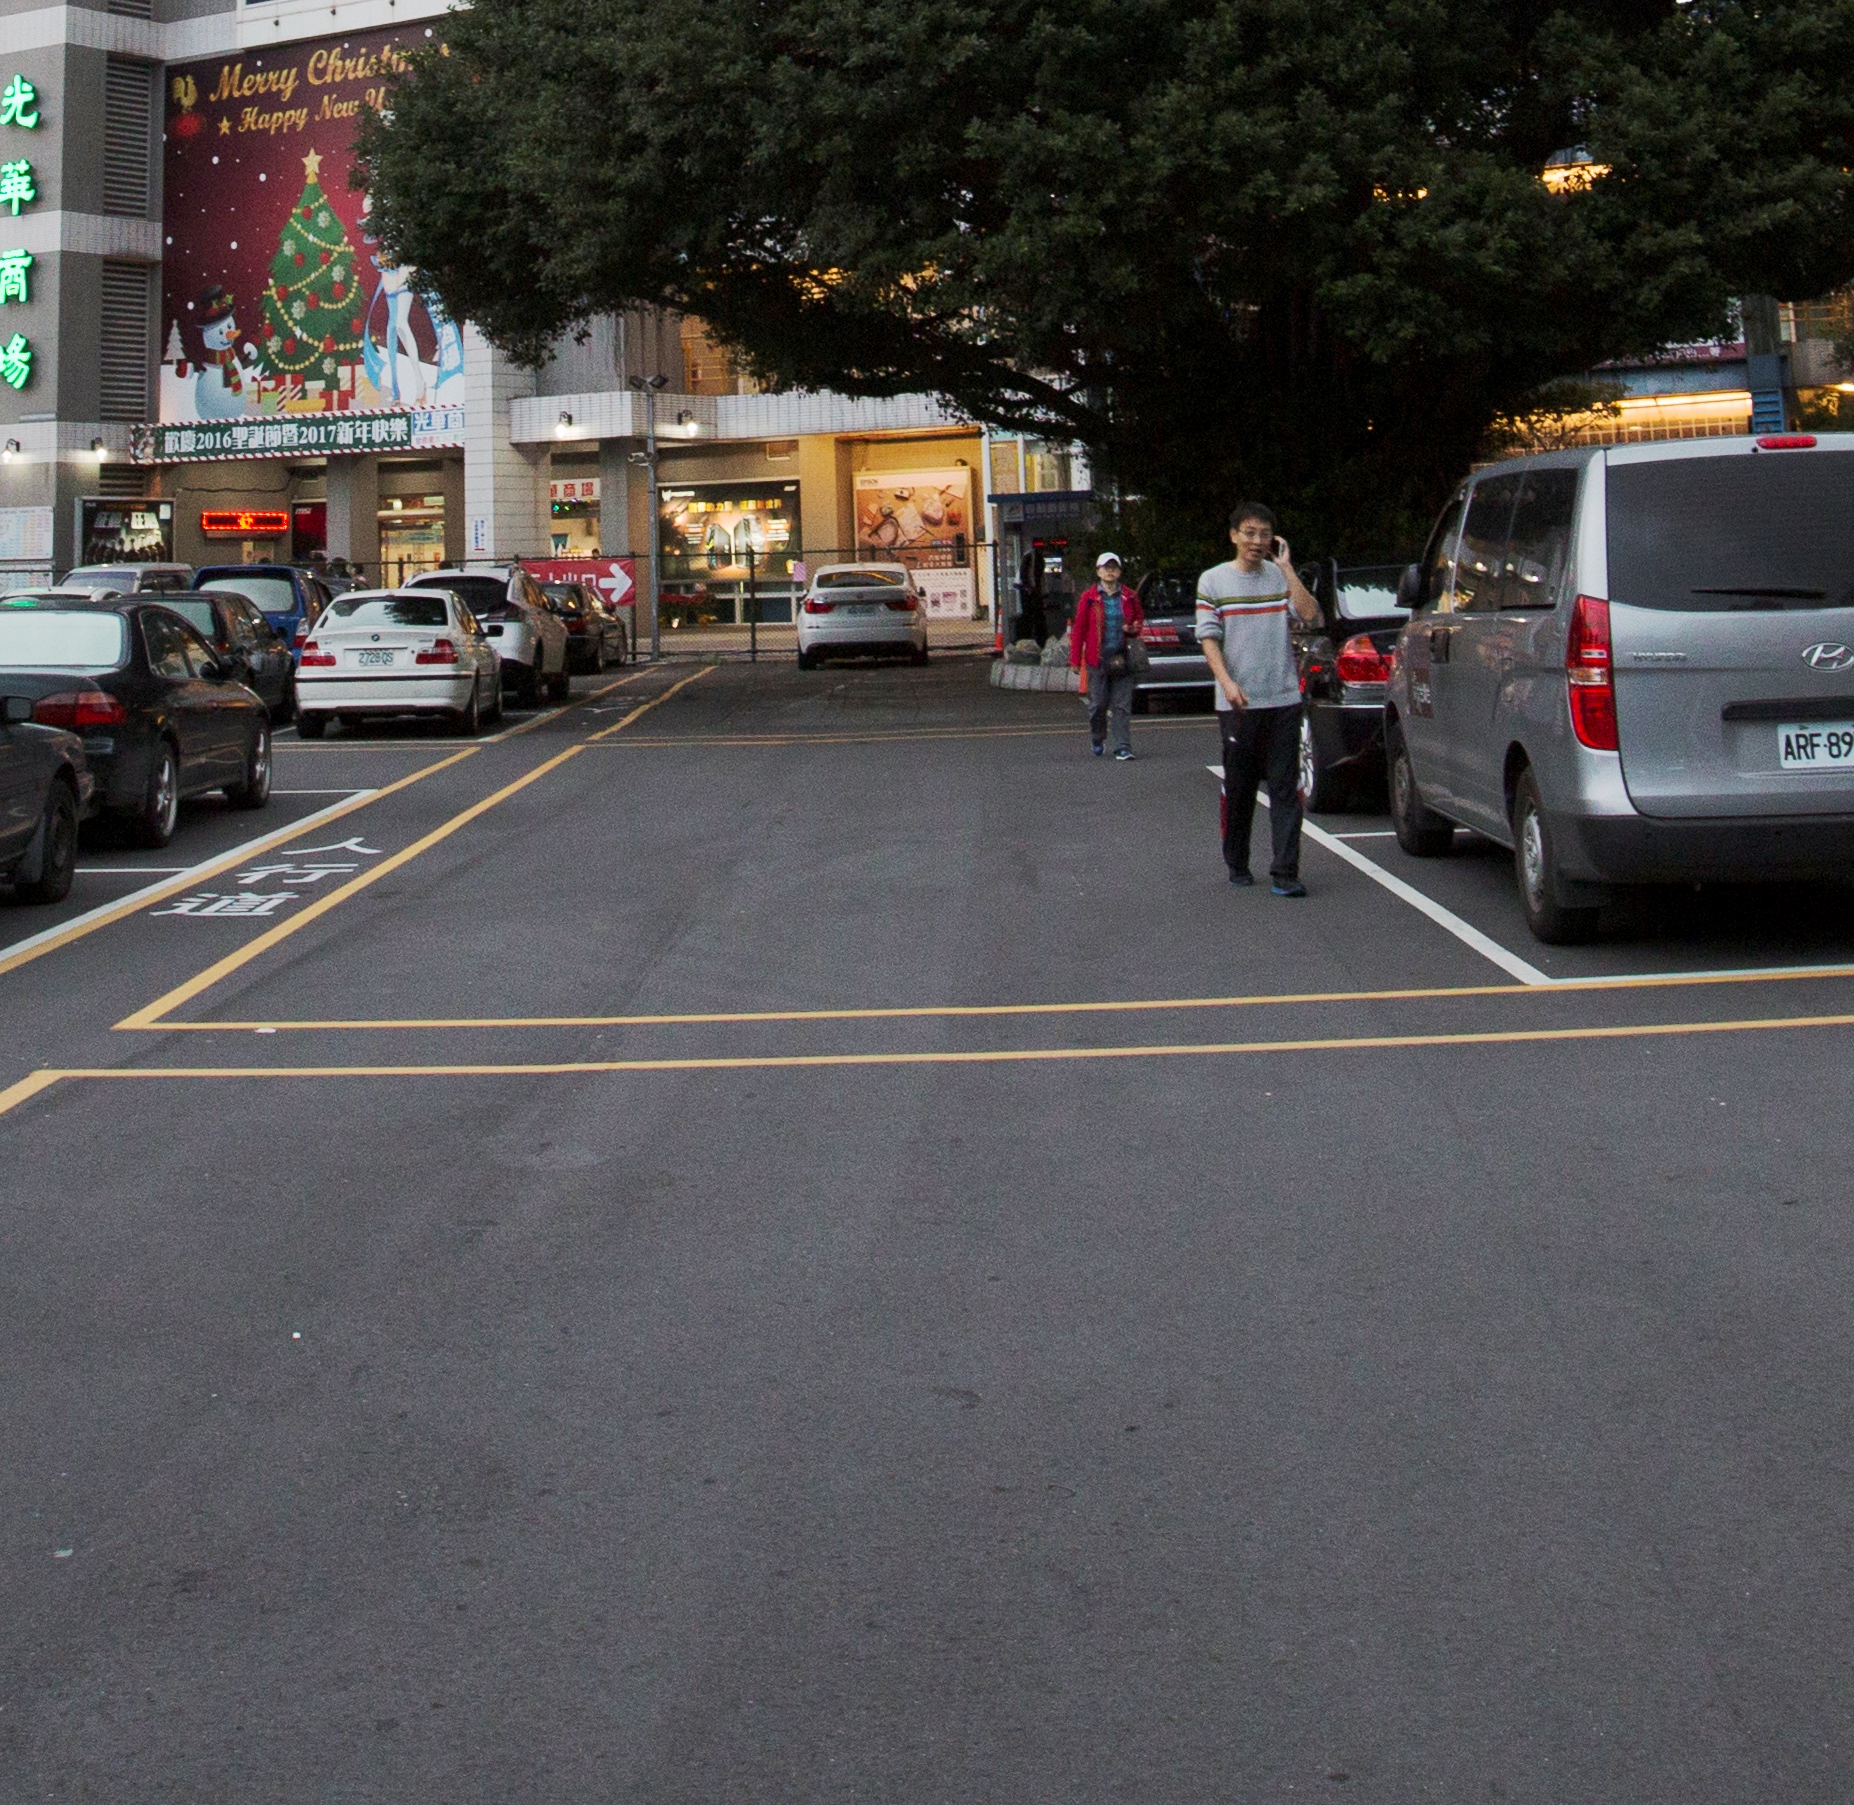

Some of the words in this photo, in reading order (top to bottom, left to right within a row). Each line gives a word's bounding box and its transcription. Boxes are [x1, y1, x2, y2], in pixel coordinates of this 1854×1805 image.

[209, 62, 299, 102] Merry
[307, 43, 450, 86] Christm
[237, 106, 309, 136] Happy
[315, 94, 358, 122] New
[149, 836, 384, 917] 人行道
